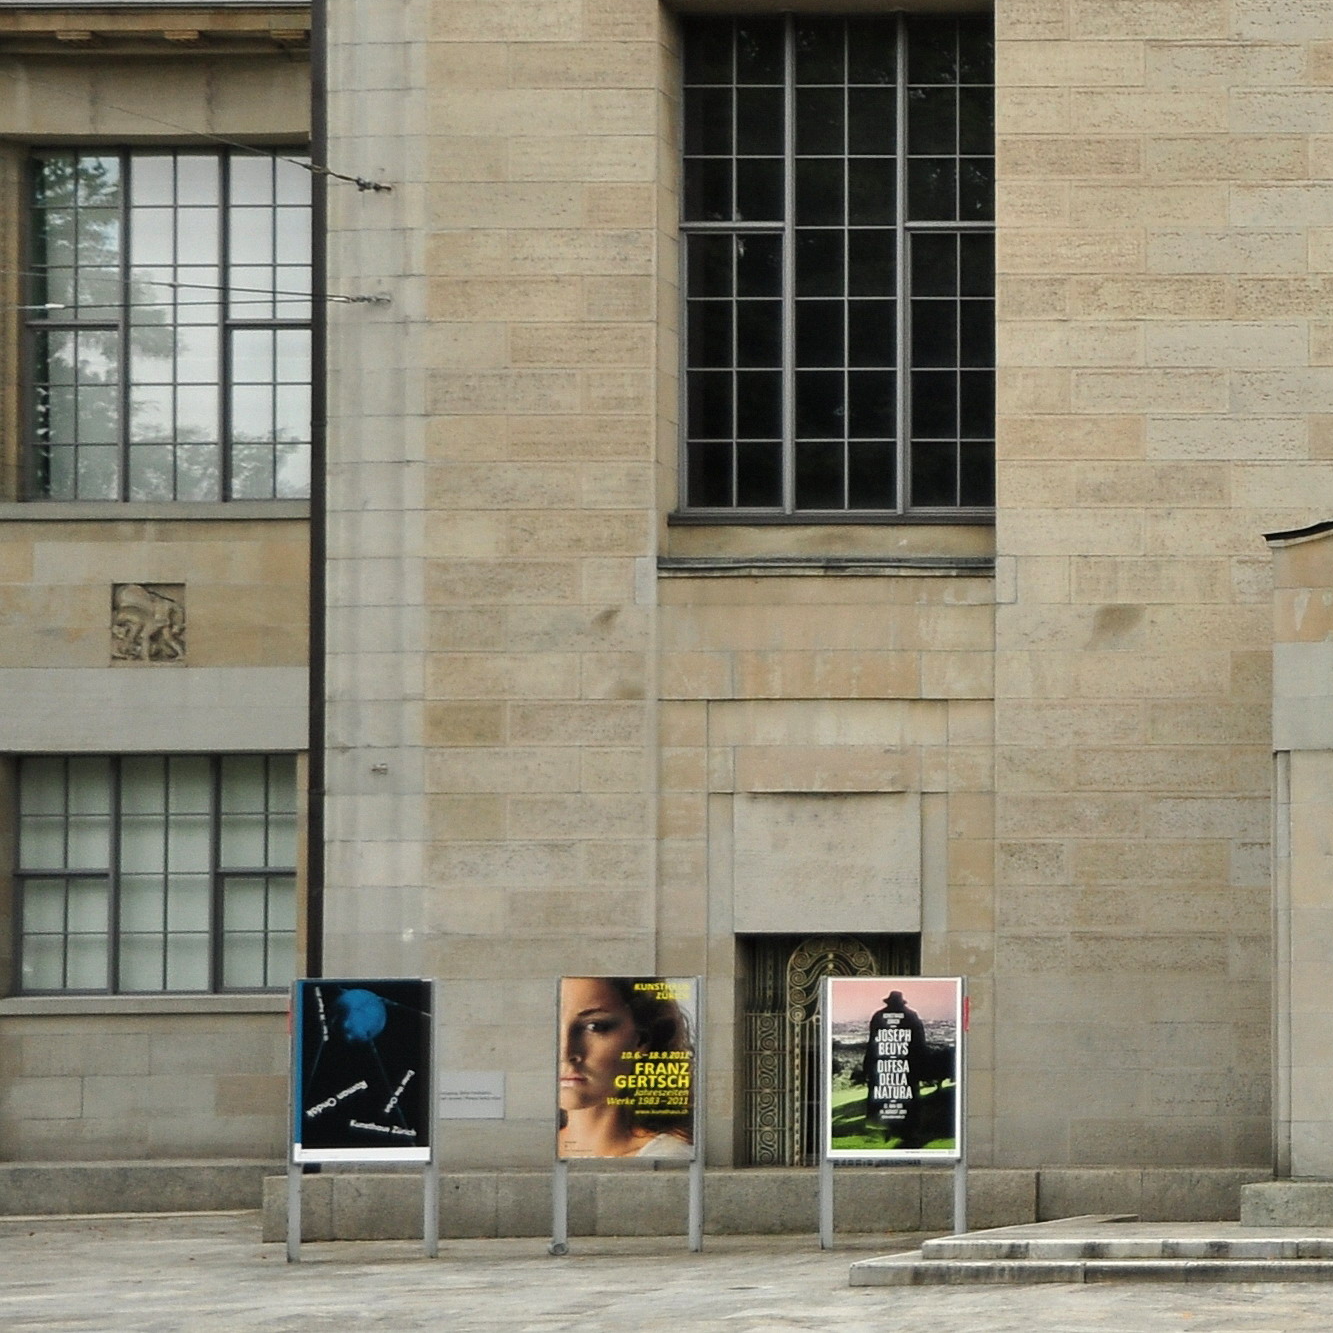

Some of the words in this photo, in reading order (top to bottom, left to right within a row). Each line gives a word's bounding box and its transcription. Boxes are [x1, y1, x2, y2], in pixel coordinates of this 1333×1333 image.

[875, 1029, 912, 1042] JOSEPH
[878, 1042, 909, 1056] BEUYS
[635, 1062, 690, 1075] FRANZ
[877, 1059, 910, 1073] DIFESA
[614, 1075, 690, 1088] GERTSCH
[879, 1073, 908, 1086] DELLA
[873, 1086, 914, 1099] NATURA
